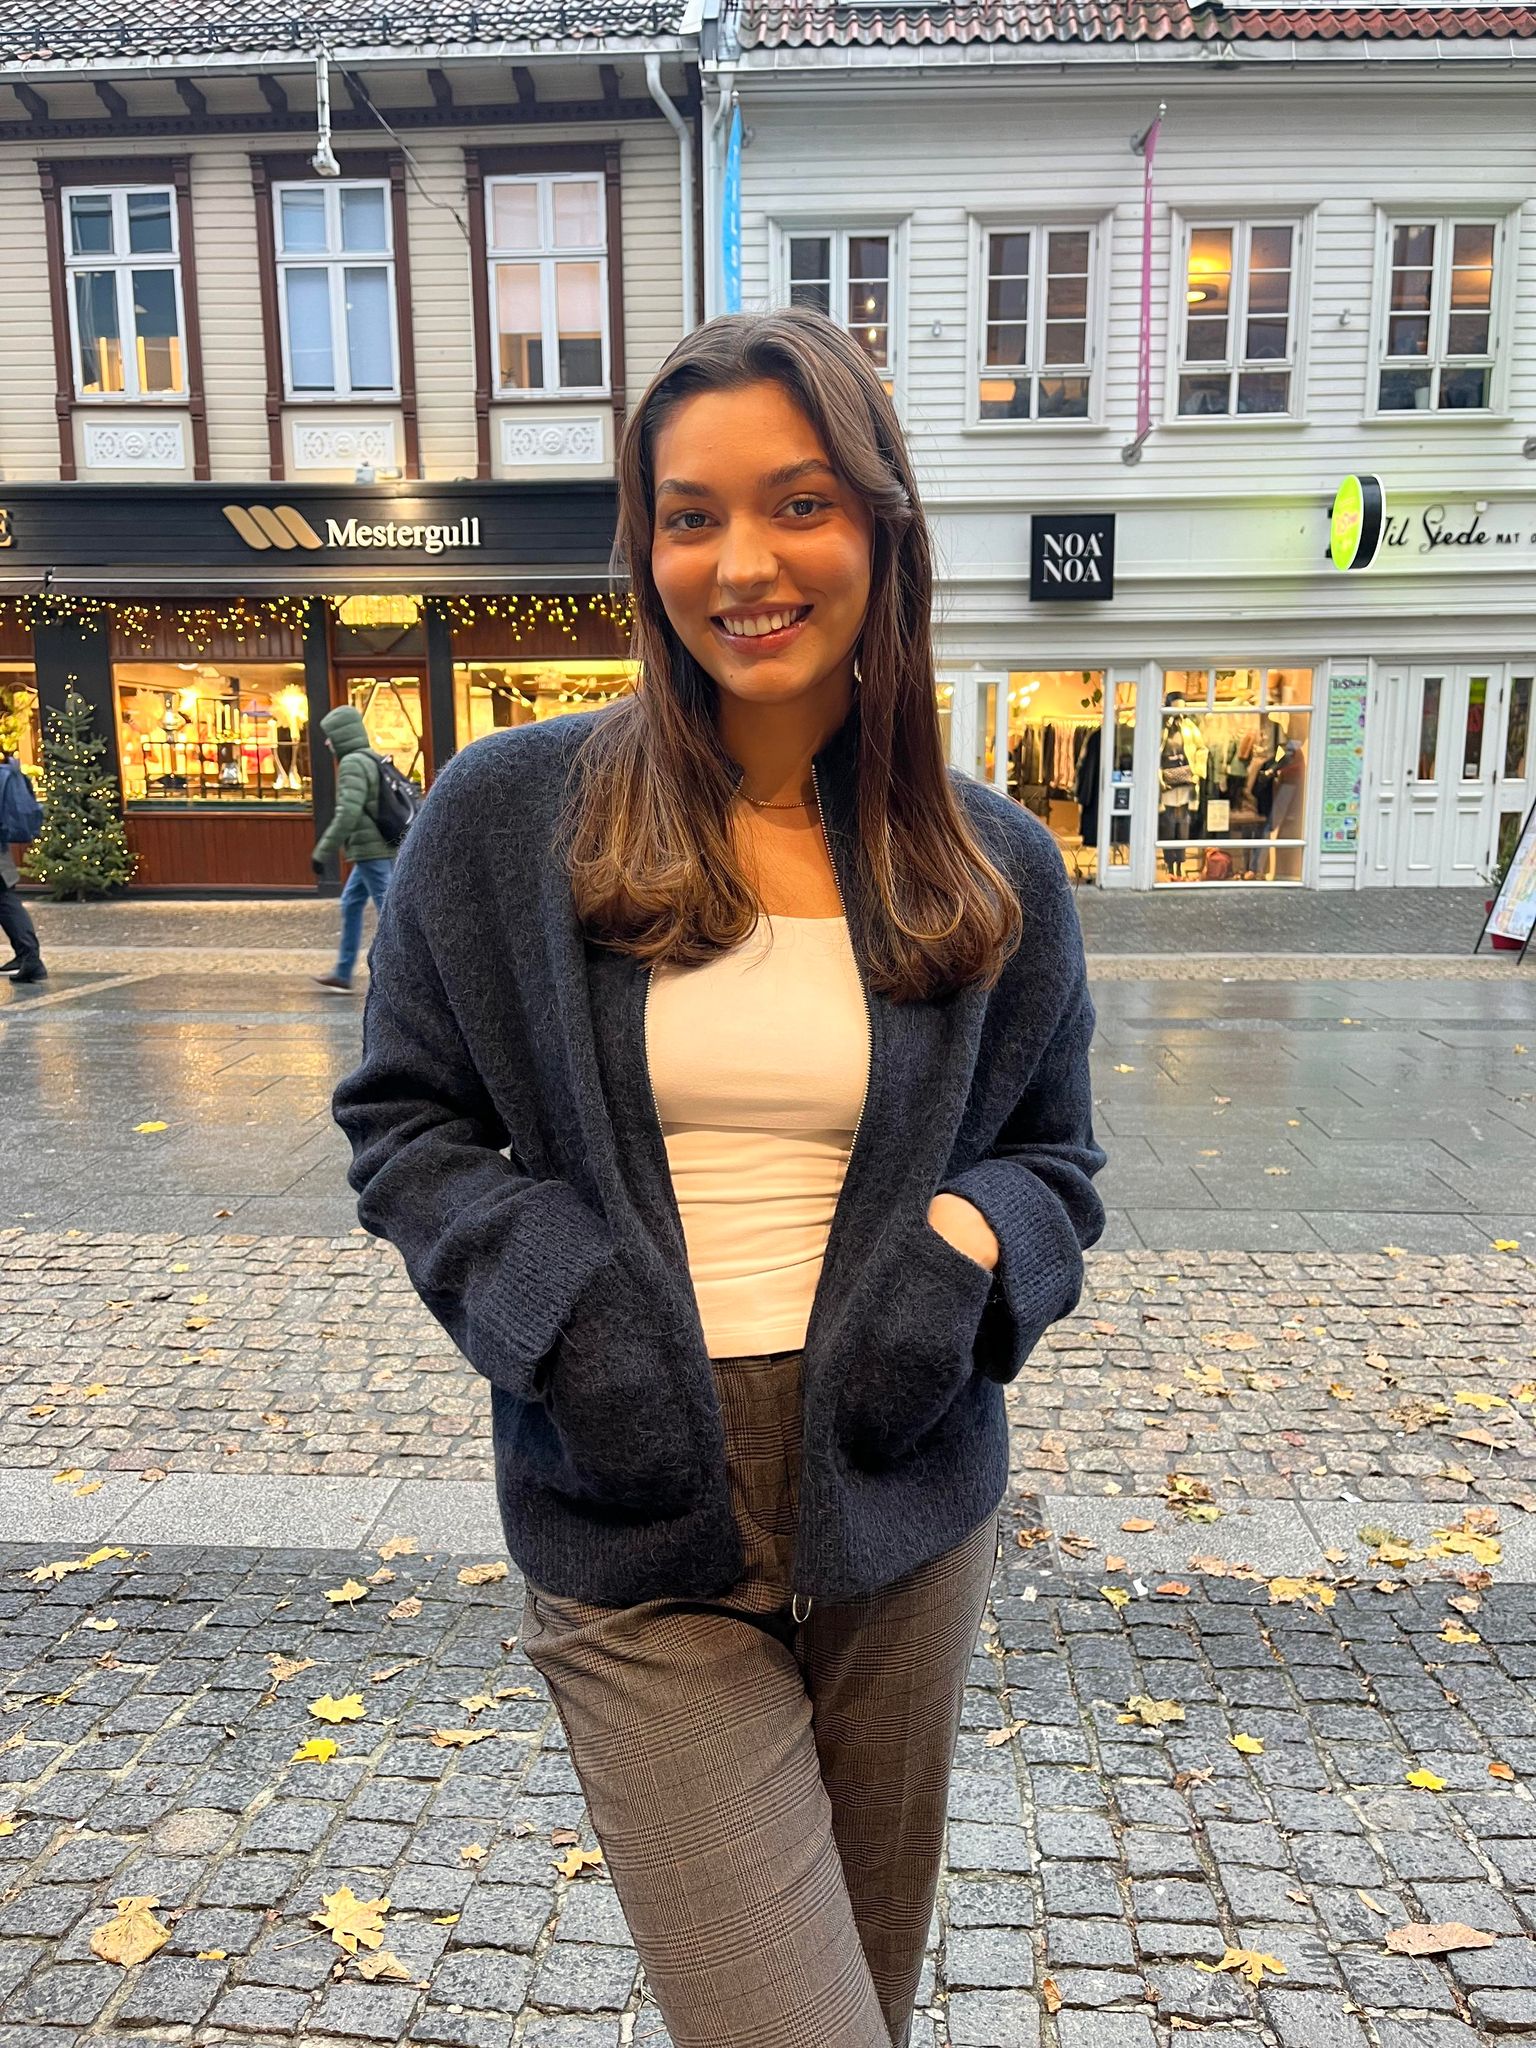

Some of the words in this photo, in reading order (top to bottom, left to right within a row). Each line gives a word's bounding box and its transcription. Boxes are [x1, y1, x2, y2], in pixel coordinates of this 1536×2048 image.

[325, 517, 481, 555] Mestergull
[1042, 532, 1103, 557] NOA
[1496, 532, 1520, 544] MAT
[1042, 558, 1102, 583] NOA
